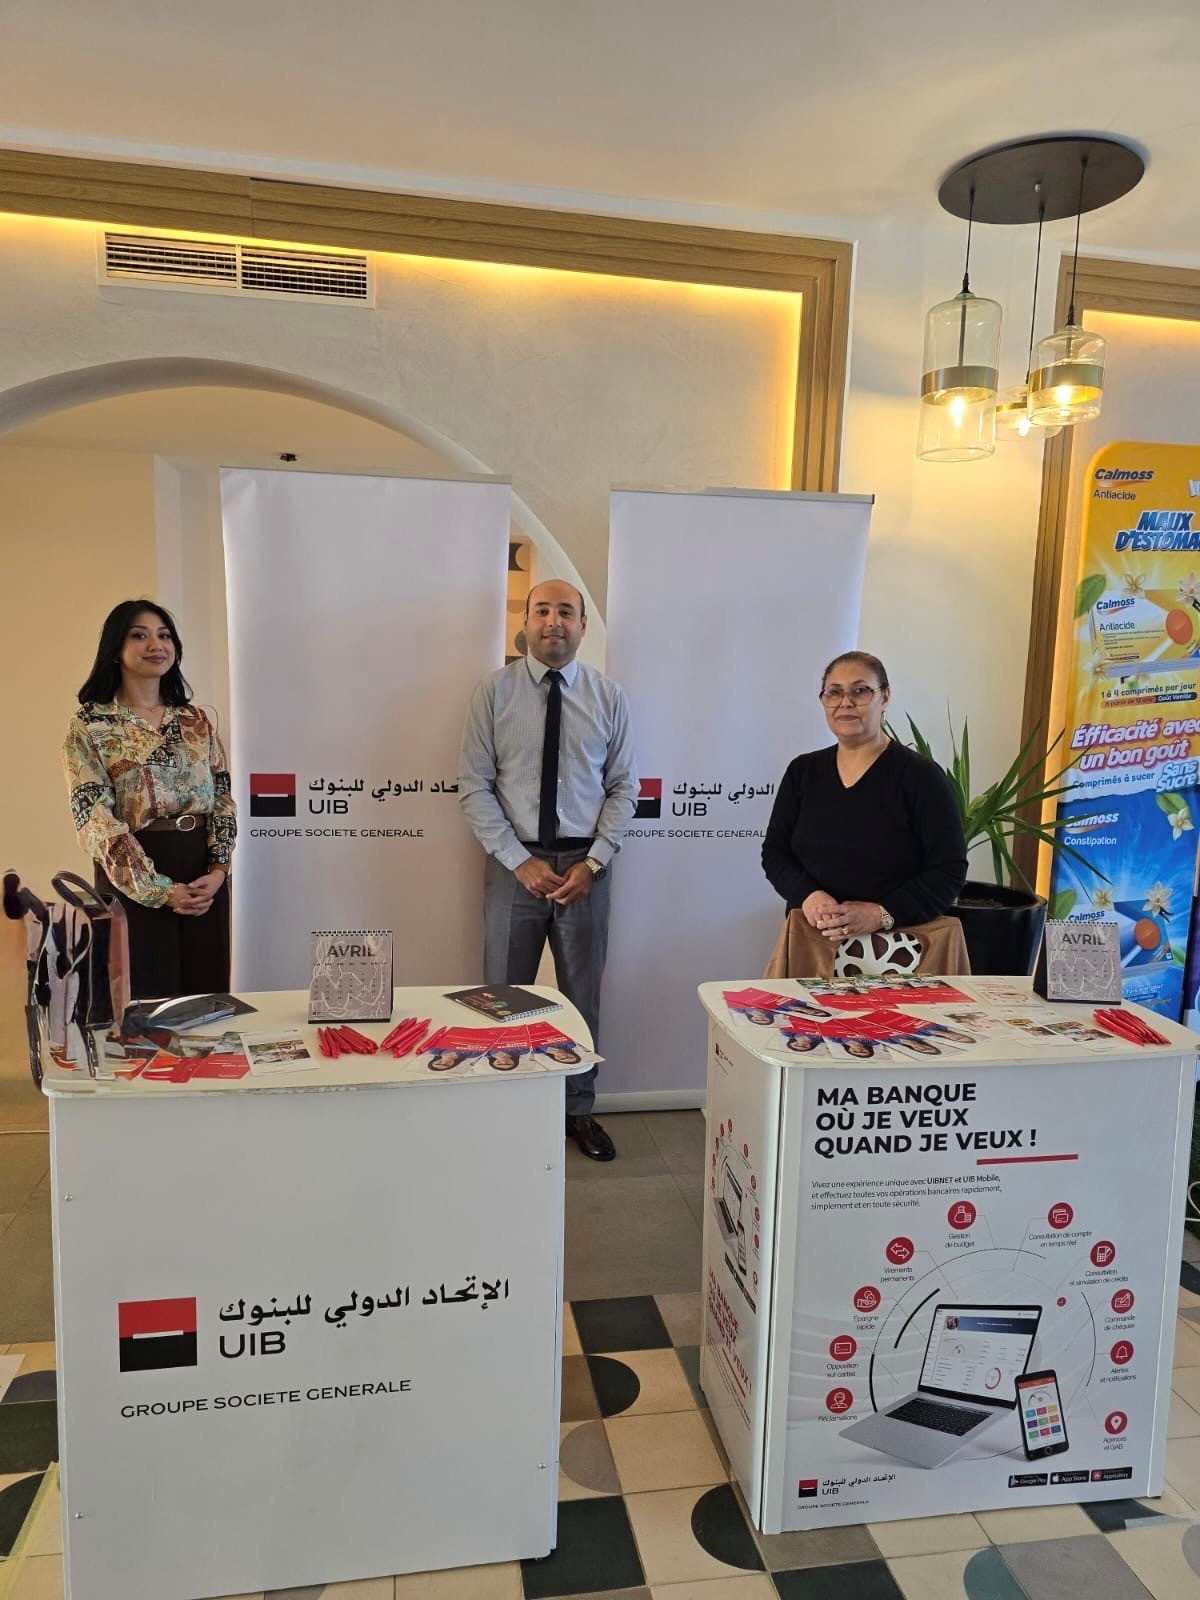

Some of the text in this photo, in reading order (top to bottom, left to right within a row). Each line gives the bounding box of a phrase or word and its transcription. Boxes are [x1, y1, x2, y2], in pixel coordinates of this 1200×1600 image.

[1094, 468, 1154, 480] Calmoss
[1093, 489, 1136, 501] Antiacide
[1136, 510, 1194, 531] MAUX
[1115, 530, 1200, 551] D'ESTOMA
[1096, 598, 1136, 611] Calmoss
[1099, 620, 1136, 632] Antiacide
[1121, 684, 1164, 696] comprimés
[1165, 684, 1179, 692] par
[1180, 682, 1197, 692] jour
[1071, 718, 1162, 749] Éfficacité
[1079, 739, 1190, 771] un bon goût
[1163, 760, 1198, 776] Sans
[1124, 774, 1130, 782] à
[1131, 772, 1156, 781] sucer
[1156, 773, 1197, 792] Sucre
[308, 777, 364, 797] للبنوك
[371, 780, 423, 803] الدولي
[672, 781, 775, 805] الدولي للبنوك
[308, 799, 349, 815] UIB
[671, 802, 708, 817] UIB
[250, 828, 424, 838] GROUPE SOCIETE GENERALE
[667, 829, 714, 838] SOCIETE
[1064, 836, 1117, 847] Constipation
[1062, 933, 1106, 946] AVRIL
[327, 944, 377, 958] AVRIL
[817, 1083, 977, 1107] MA BANQUE
[815, 1107, 969, 1131] OÙ JE VEUX
[814, 1128, 1037, 1159] QUAND JE VEUX !
[812, 1180, 830, 1189] Vivez
[846, 1179, 884, 1189] expérience
[885, 1178, 910, 1187] unique
[910, 1178, 926, 1186] avec
[926, 1176, 954, 1185] UIBNET
[954, 1176, 962, 1184] et
[962, 1175, 976, 1183] UIB
[811, 1192, 819, 1200] et
[819, 1191, 852, 1199] effectuez
[852, 1190, 875, 1198] toutes
[889, 1187, 927, 1198] opérations
[927, 1186, 960, 1196] bancaires
[961, 1185, 1002, 1195] rapidement,
[811, 1201, 853, 1211] simplement
[853, 1201, 861, 1209] et
[872, 1200, 892, 1208] toute
[892, 1199, 921, 1208] sécurité.
[948, 1232, 971, 1240] Gestion
[944, 1240, 975, 1250] de budget
[884, 1266, 913, 1274] Virements
[880, 1274, 915, 1284] permanents
[218, 1274, 510, 1328] الإتحاد الدولي للبنوك
[218, 1330, 287, 1359] UIB
[120, 1379, 412, 1419] GROUPE SOCIETE GENERALE
[821, 1487, 839, 1495] UIB
